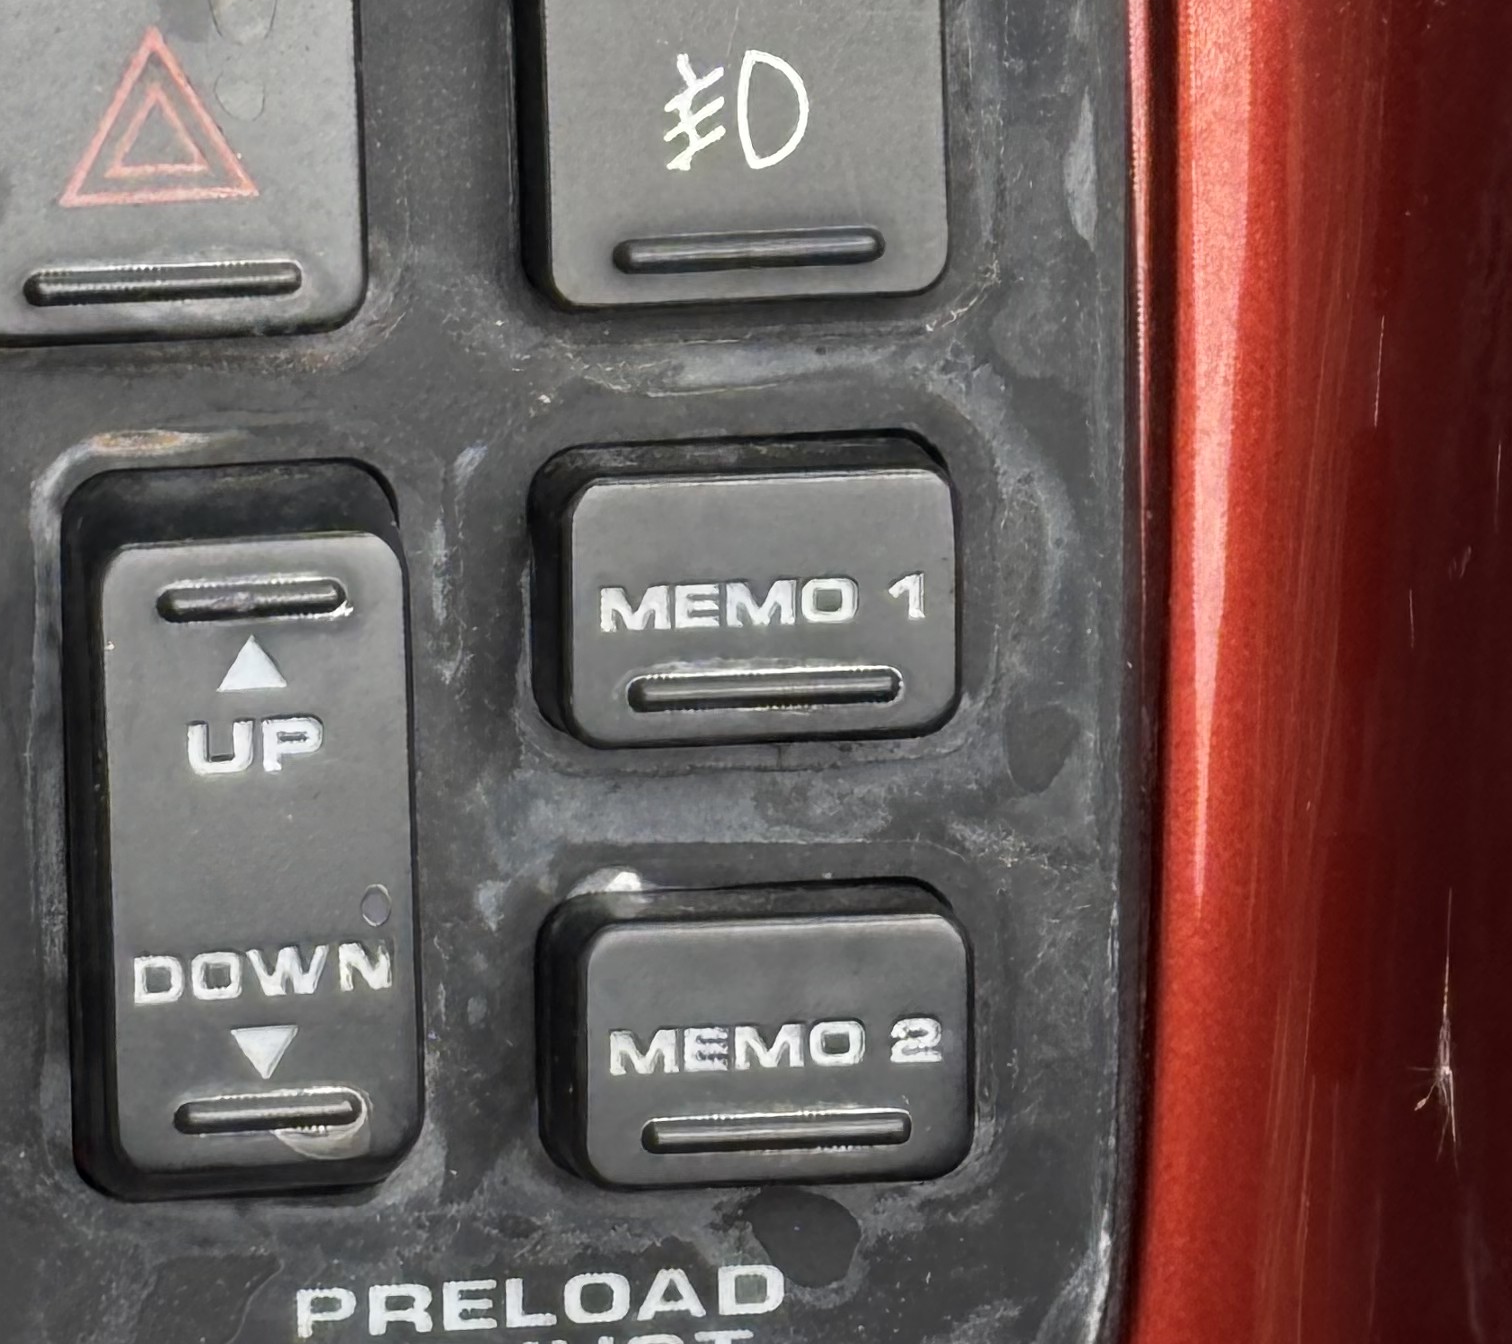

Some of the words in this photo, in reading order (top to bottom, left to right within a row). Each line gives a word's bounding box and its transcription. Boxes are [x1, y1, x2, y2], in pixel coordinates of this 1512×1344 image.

[598, 577, 859, 633] MEMO
[888, 572, 927, 622] 1
[186, 717, 324, 782] UP
[132, 941, 393, 1008] DOWN
[608, 1019, 867, 1077] MEMO
[888, 1016, 944, 1065] 2
[294, 1264, 786, 1340] PRELOAD
